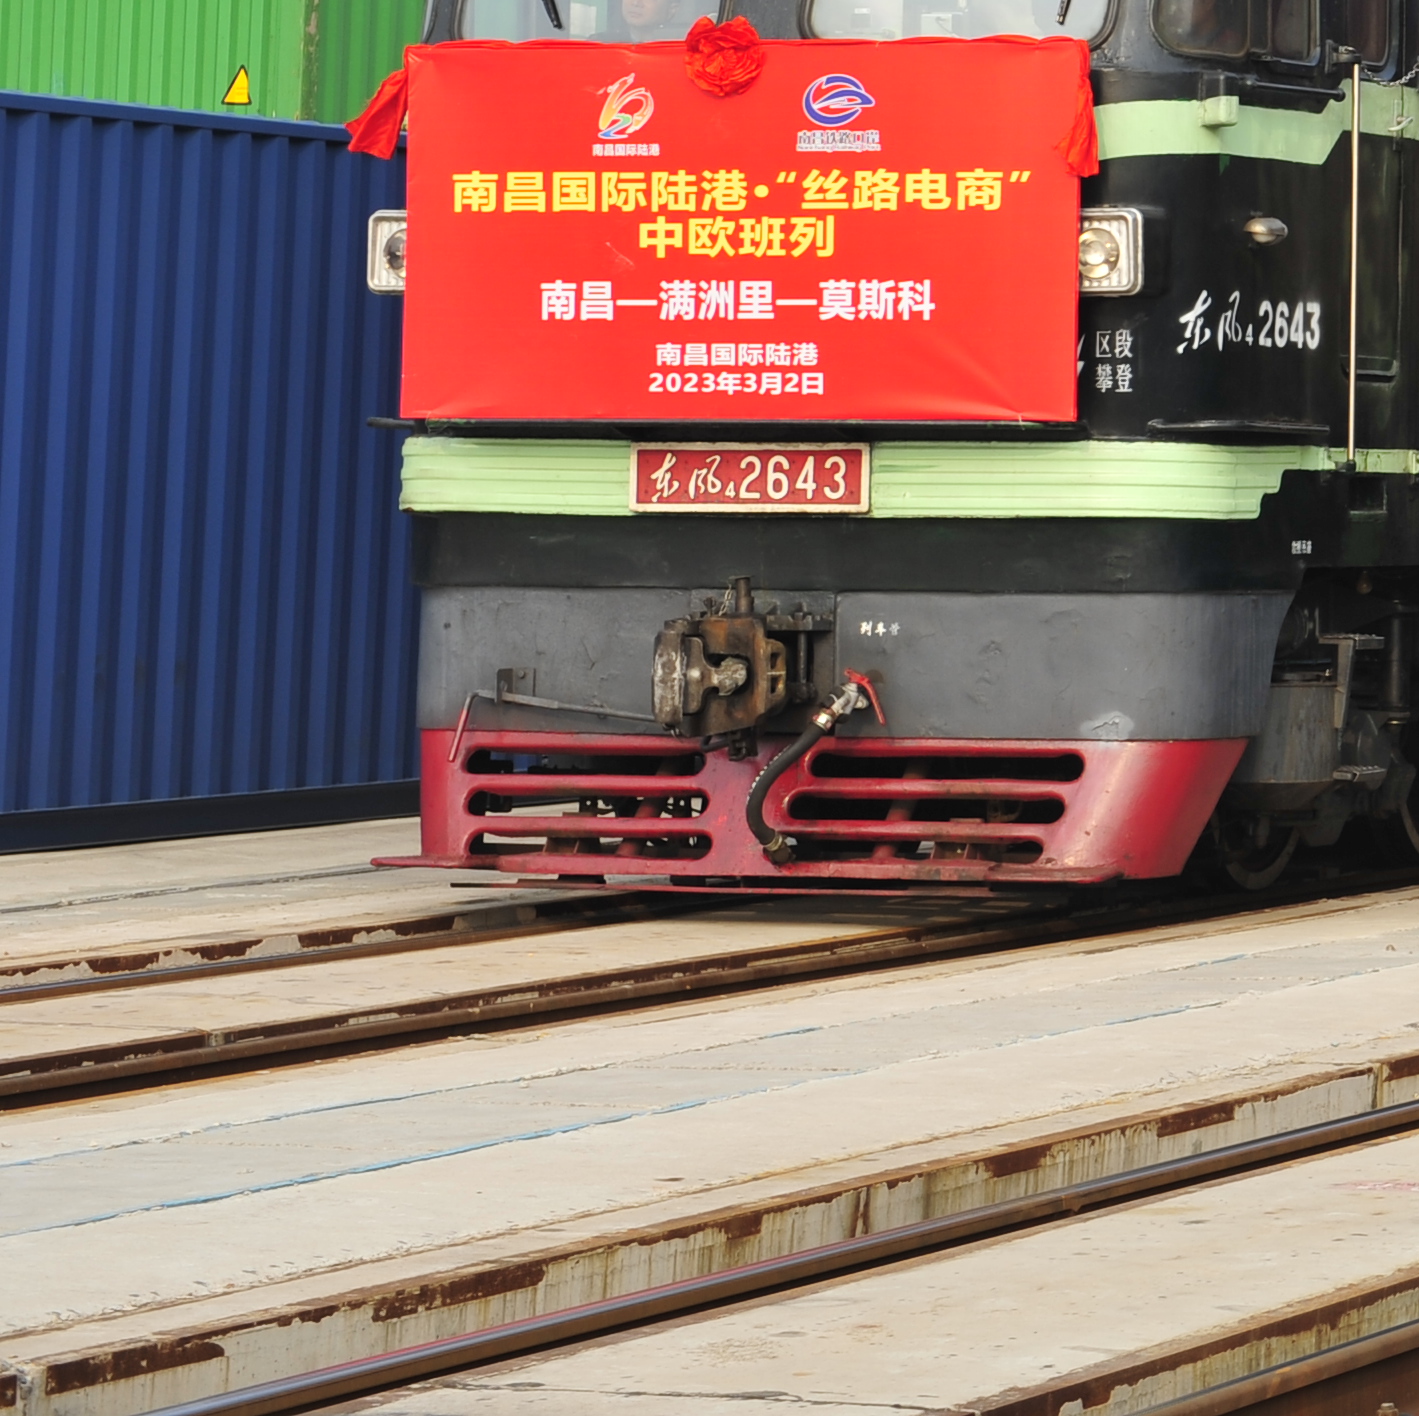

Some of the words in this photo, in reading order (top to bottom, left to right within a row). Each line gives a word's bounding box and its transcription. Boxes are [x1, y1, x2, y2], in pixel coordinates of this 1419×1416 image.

[592, 143, 660, 157] 南昌国际陆港
[797, 130, 879, 145] 南昌铁路口岸
[639, 215, 835, 259] 中欧班列
[655, 342, 819, 367] 南昌国际陆港
[1095, 328, 1133, 358] 区段
[648, 371, 824, 396] 2023年3月2日
[1095, 363, 1133, 392] 攀登
